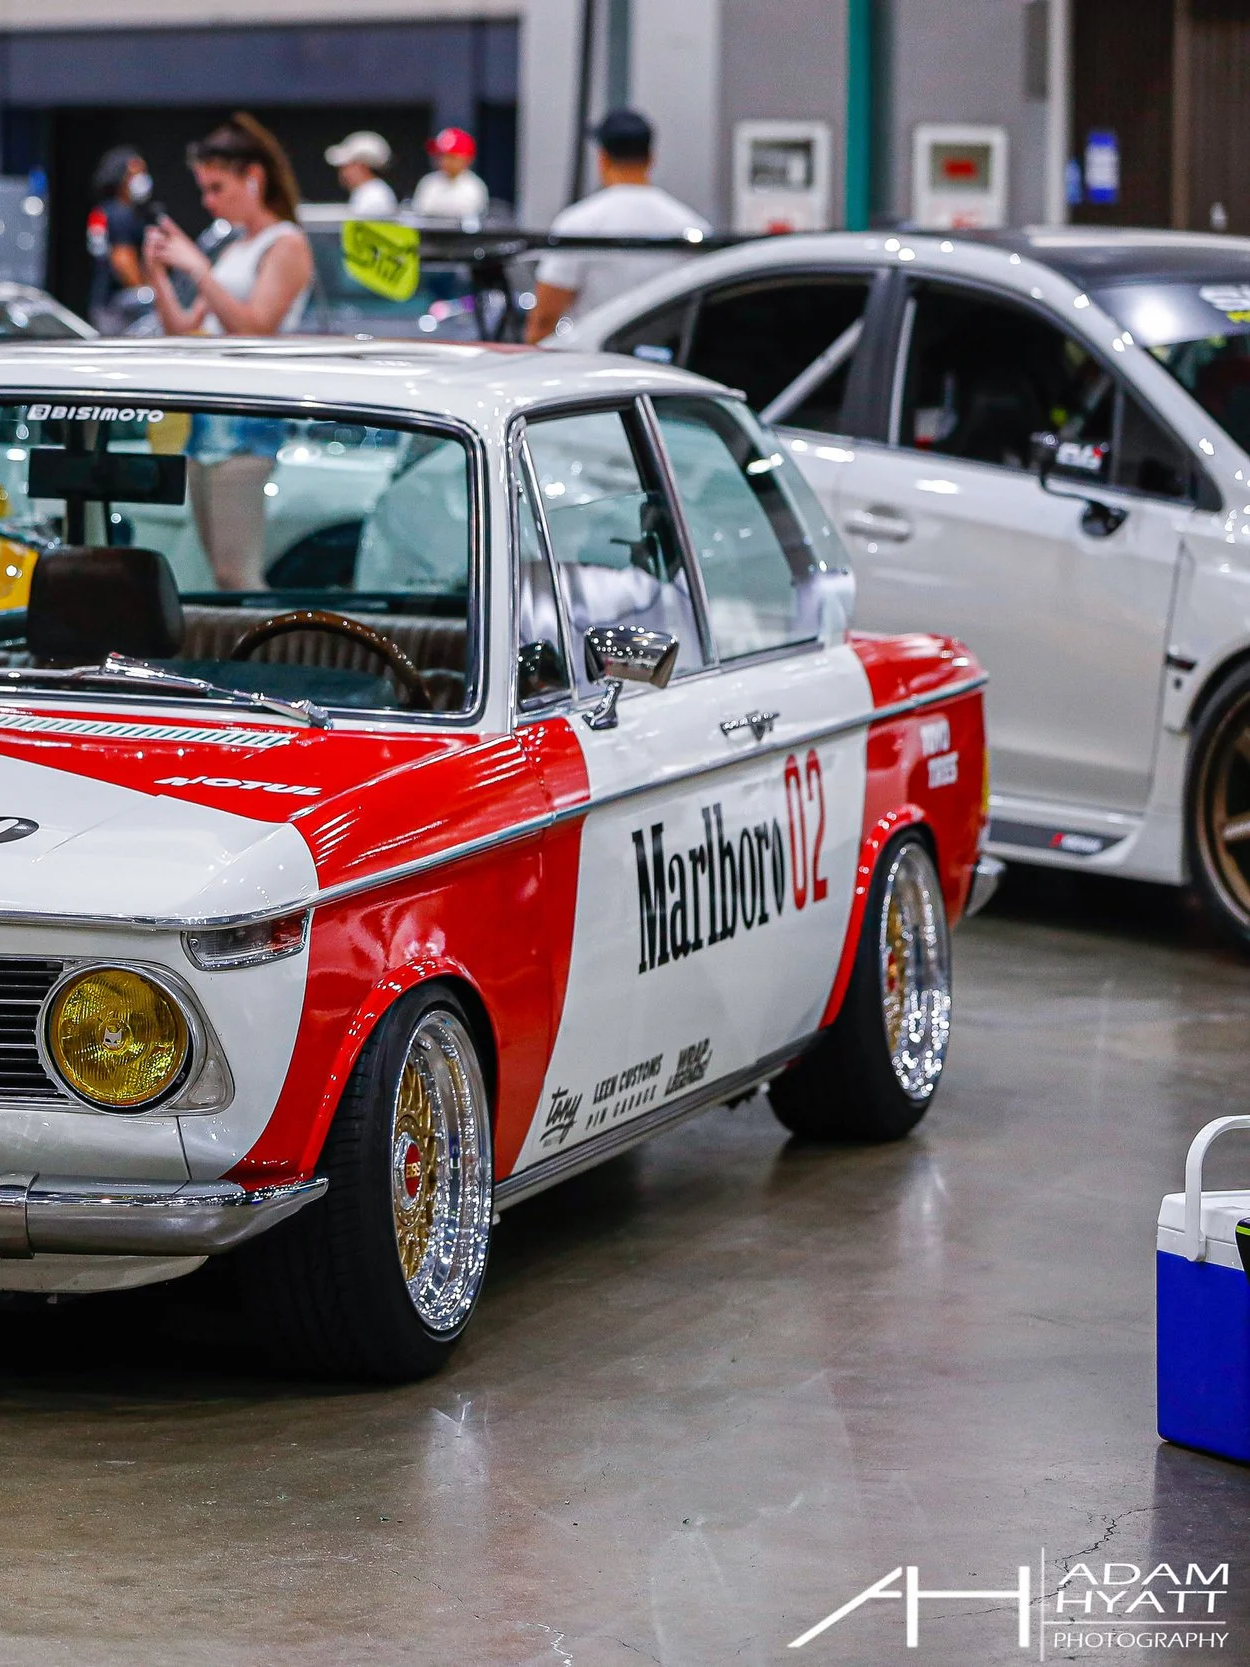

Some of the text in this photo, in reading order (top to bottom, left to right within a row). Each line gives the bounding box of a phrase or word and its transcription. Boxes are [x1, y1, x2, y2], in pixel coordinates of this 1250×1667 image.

[50, 406, 165, 423] BISIMOTO
[154, 775, 322, 796] MOTUL
[632, 748, 828, 974] Marlboro 02
